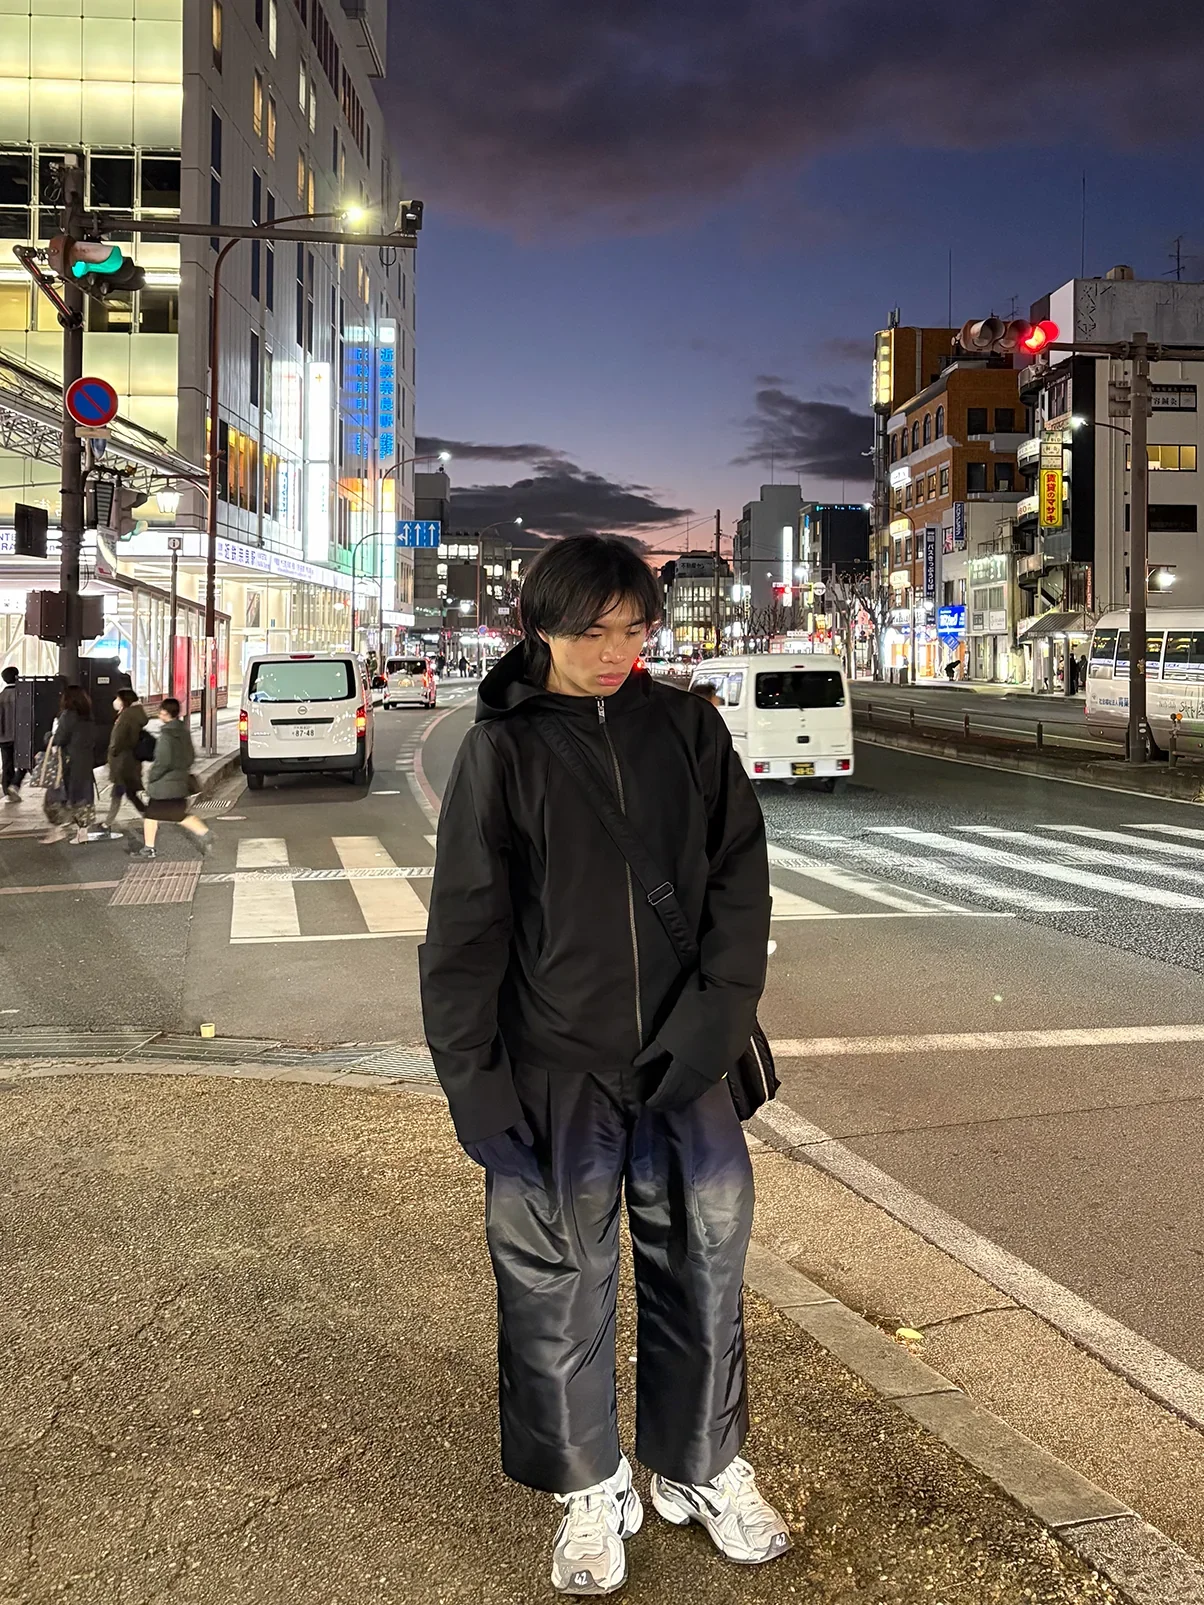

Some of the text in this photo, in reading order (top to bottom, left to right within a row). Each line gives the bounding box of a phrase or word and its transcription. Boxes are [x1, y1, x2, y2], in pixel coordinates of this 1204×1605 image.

[380, 348, 394, 428] 近鉄奈良駅
[1046, 473, 1056, 523] 賃貸のマサキ
[927, 543, 935, 590] バスきっぷうりば
[774, 1533, 787, 1546] 42
[574, 1572, 587, 1585] 42
